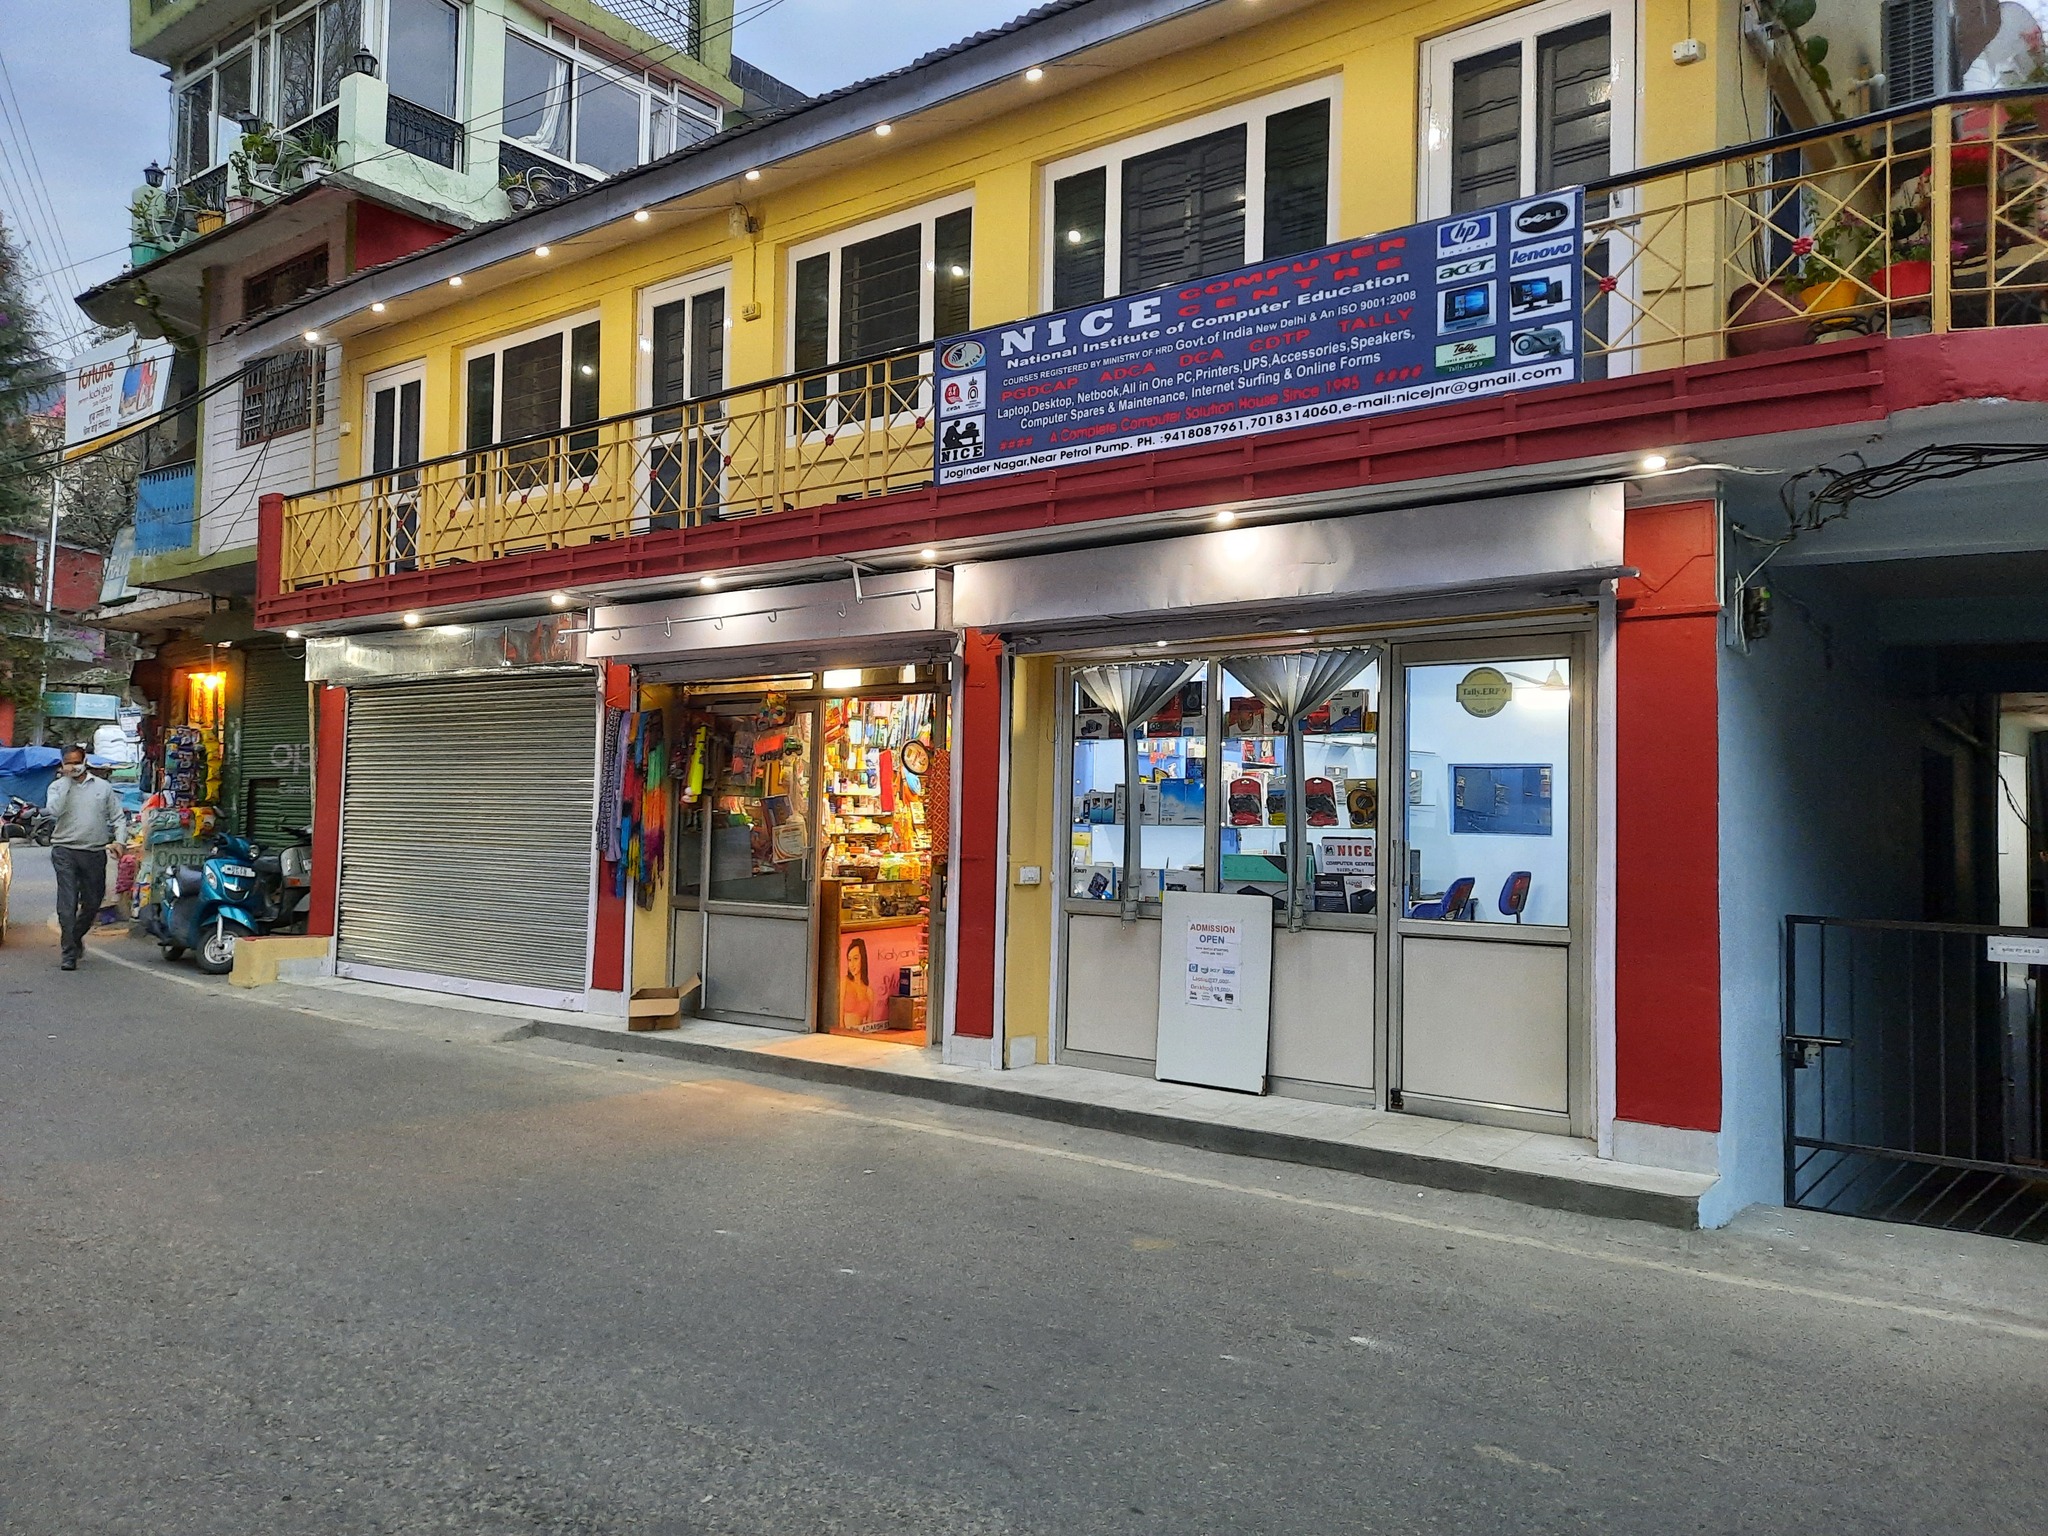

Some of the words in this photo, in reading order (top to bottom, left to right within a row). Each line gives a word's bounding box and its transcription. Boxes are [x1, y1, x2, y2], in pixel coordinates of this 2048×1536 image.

[1518, 209, 1566, 227] DELL
[1439, 257, 1494, 280] acer
[1511, 243, 1572, 265] lenovo
[1000, 296, 1161, 357] NICE
[1178, 237, 1407, 300] COMPUTER
[1177, 256, 1402, 317] CENTRE
[1007, 346, 1077, 369] National
[1083, 328, 1160, 352] Institute
[1166, 322, 1185, 335] of
[1191, 300, 1291, 329] Computer
[1297, 272, 1410, 306] Education
[1001, 377, 1079, 402] PGDCAP
[1098, 362, 1157, 383] ADCA
[1179, 348, 1225, 367] DCA
[1249, 329, 1311, 352] CDTP
[1338, 307, 1414, 333] TALLY
[1003, 372, 1038, 387] COURSES
[1040, 363, 1089, 378] REGISTERED
[1090, 359, 1102, 369] BY
[1102, 351, 1140, 366] MINISTRY
[1142, 349, 1154, 358] OF
[1155, 344, 1174, 355] HRD
[1175, 332, 1220, 351] Govt.of
[1222, 325, 1253, 341] India
[1255, 322, 1278, 334] New
[1280, 314, 1307, 329] Delhi
[1309, 310, 1318, 321] &
[1319, 309, 1335, 320] An
[1337, 303, 1357, 316] ISO
[1360, 290, 1417, 311] 9001:2008
[1453, 343, 1478, 356] Tally
[997, 396, 1076, 420] Laptop,Desktop,
[1139, 380, 1149, 392] in
[1151, 375, 1173, 391] One
[1020, 412, 1068, 430] Computer
[1070, 405, 1105, 422] Spares
[1107, 402, 1116, 413] &
[1118, 392, 1189, 412] Maintenance,
[1191, 379, 1235, 398] Internet
[1237, 369, 1281, 389] Surfing
[1283, 367, 1293, 380] &
[1296, 360, 1336, 378] Online
[1340, 352, 1381, 371] Forms
[1050, 432, 1058, 443] A
[1060, 422, 1118, 443] Complete
[1120, 411, 1182, 432] Computer
[1185, 401, 1235, 421] Solution
[1238, 392, 1280, 410] House
[1283, 384, 1320, 404] Since
[1325, 374, 1360, 394] 1995
[941, 445, 983, 463] NICE
[944, 464, 991, 480] Joginder
[1060, 447, 1092, 461] Petrol
[1095, 441, 1133, 455] Pump.
[1137, 436, 1156, 447] PH.
[1337, 845, 1372, 857] NICE
[1190, 923, 1236, 934] ADMISSION
[1199, 934, 1225, 944] OPEN
[877, 948, 916, 961] Kalyani
